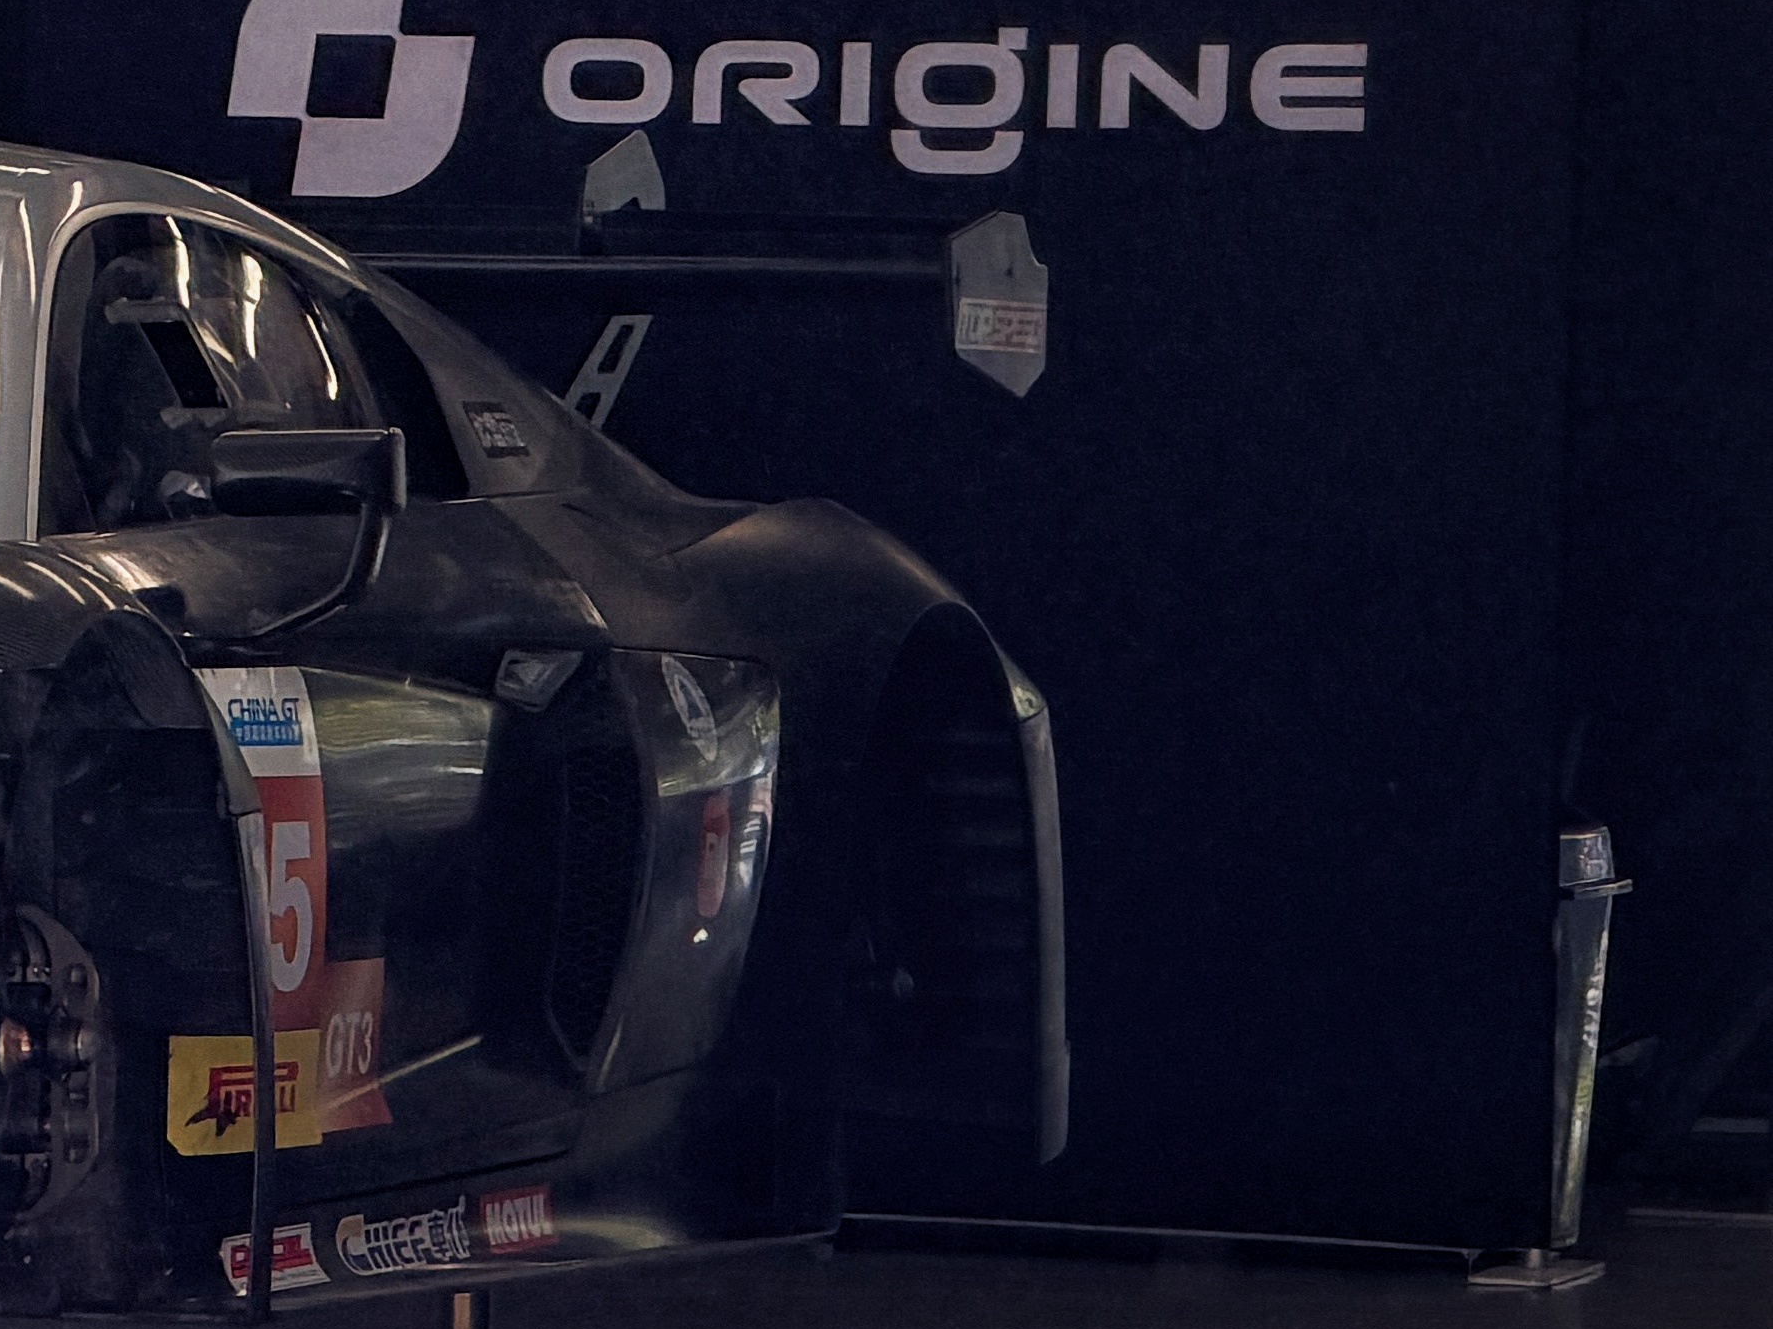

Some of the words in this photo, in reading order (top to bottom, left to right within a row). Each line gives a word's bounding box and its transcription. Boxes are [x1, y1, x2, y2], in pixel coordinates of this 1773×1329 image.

[326, 1011, 374, 1079] GT3
[210, 1061, 299, 1118] PIRLI
[486, 1193, 553, 1247] MOTUL
